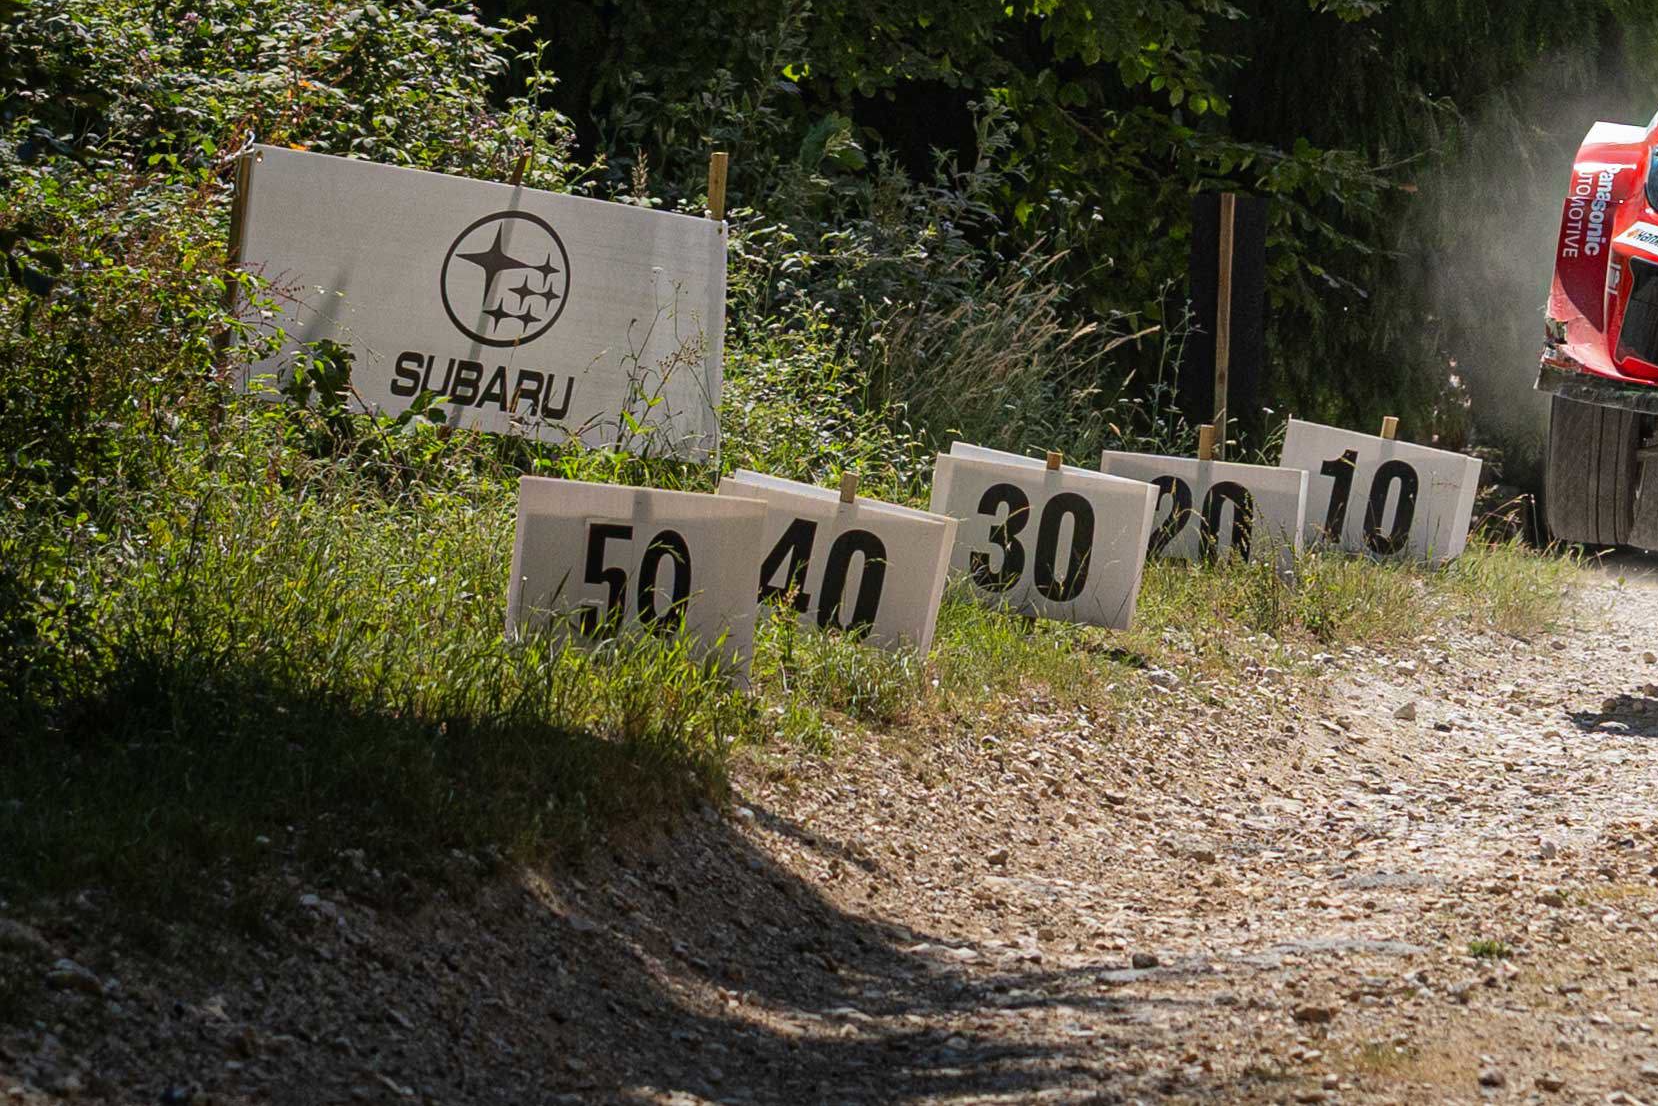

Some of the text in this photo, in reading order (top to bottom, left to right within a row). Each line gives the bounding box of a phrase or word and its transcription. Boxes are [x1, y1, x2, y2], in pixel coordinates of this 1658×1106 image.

[1563, 161, 1594, 258] UTOMOTIVE
[390, 351, 575, 420] SUBARU
[969, 483, 1095, 602] 30
[1148, 475, 1253, 566] 20
[1320, 449, 1419, 555] 10
[580, 523, 692, 640] 50
[757, 518, 887, 640] 40
